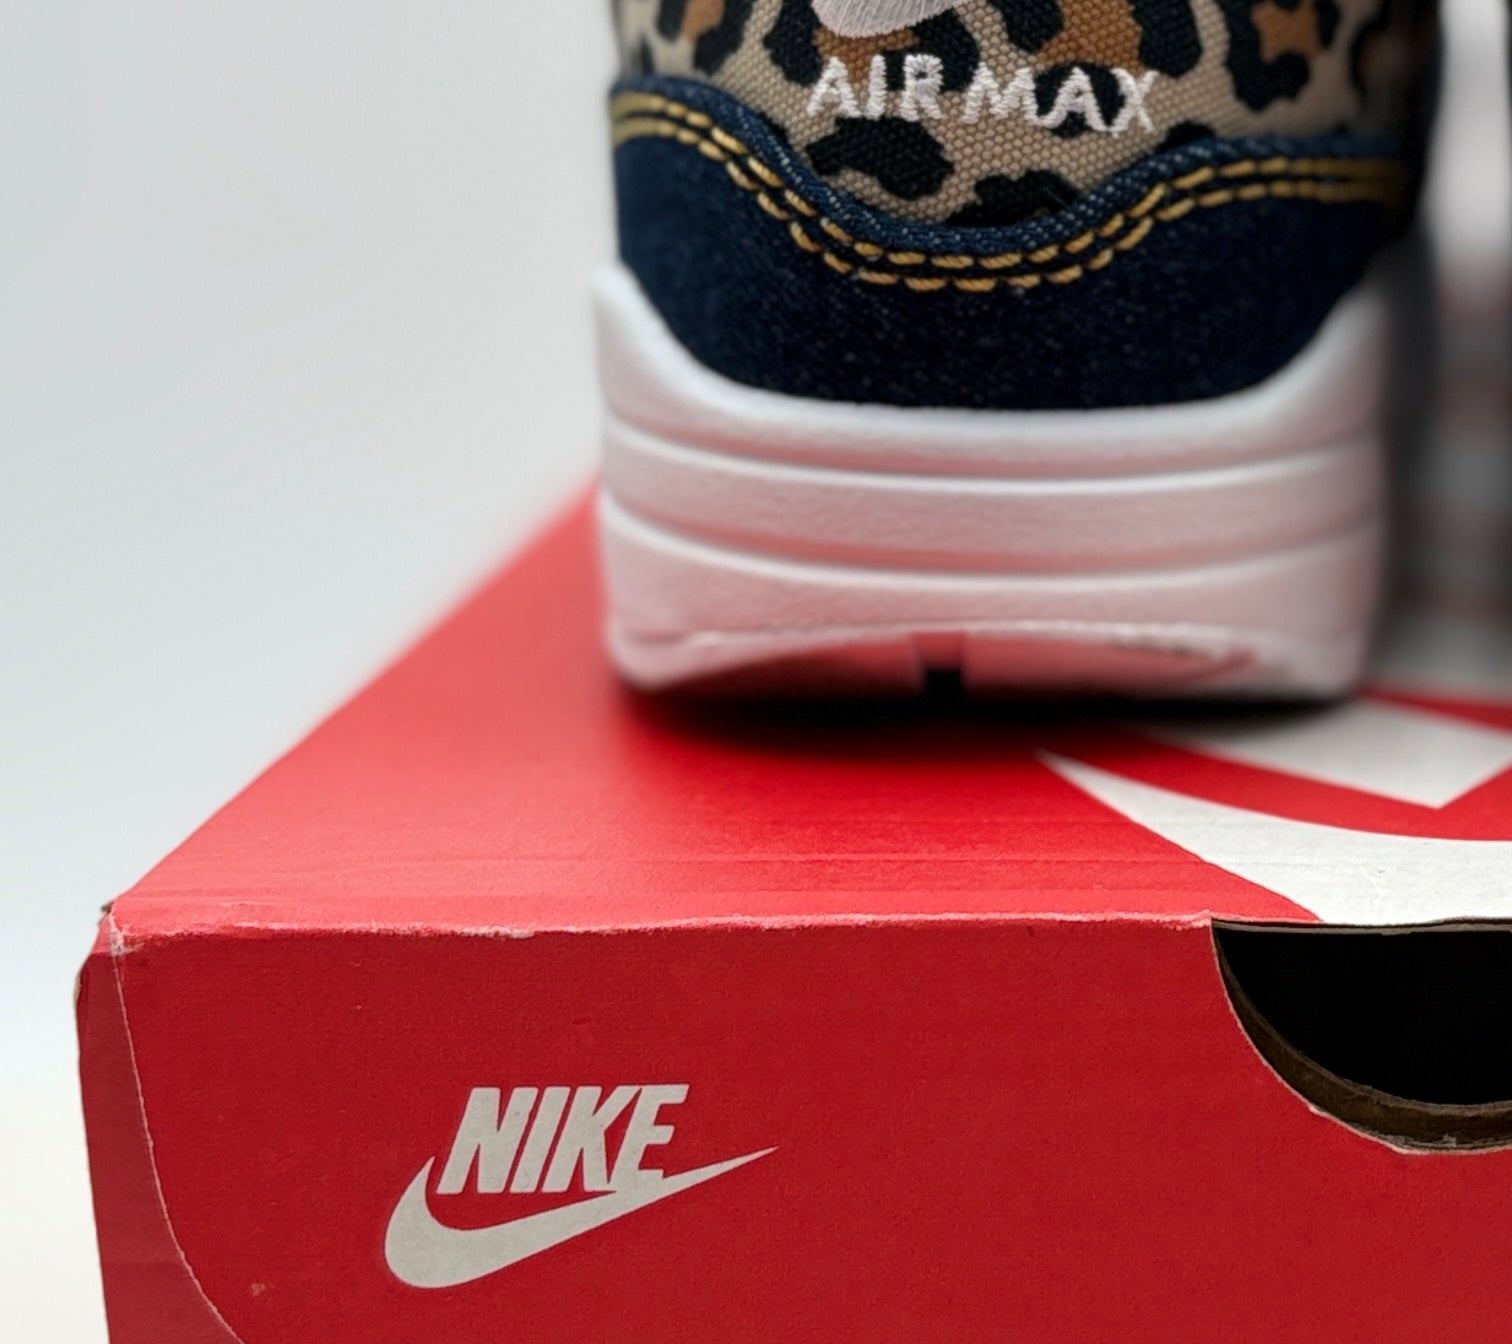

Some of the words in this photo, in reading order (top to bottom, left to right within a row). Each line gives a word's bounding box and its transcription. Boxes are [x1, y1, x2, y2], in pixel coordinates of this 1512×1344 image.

[807, 54, 944, 122] AIR
[962, 65, 1160, 138] MAX
[435, 1083, 690, 1195] NIKE
